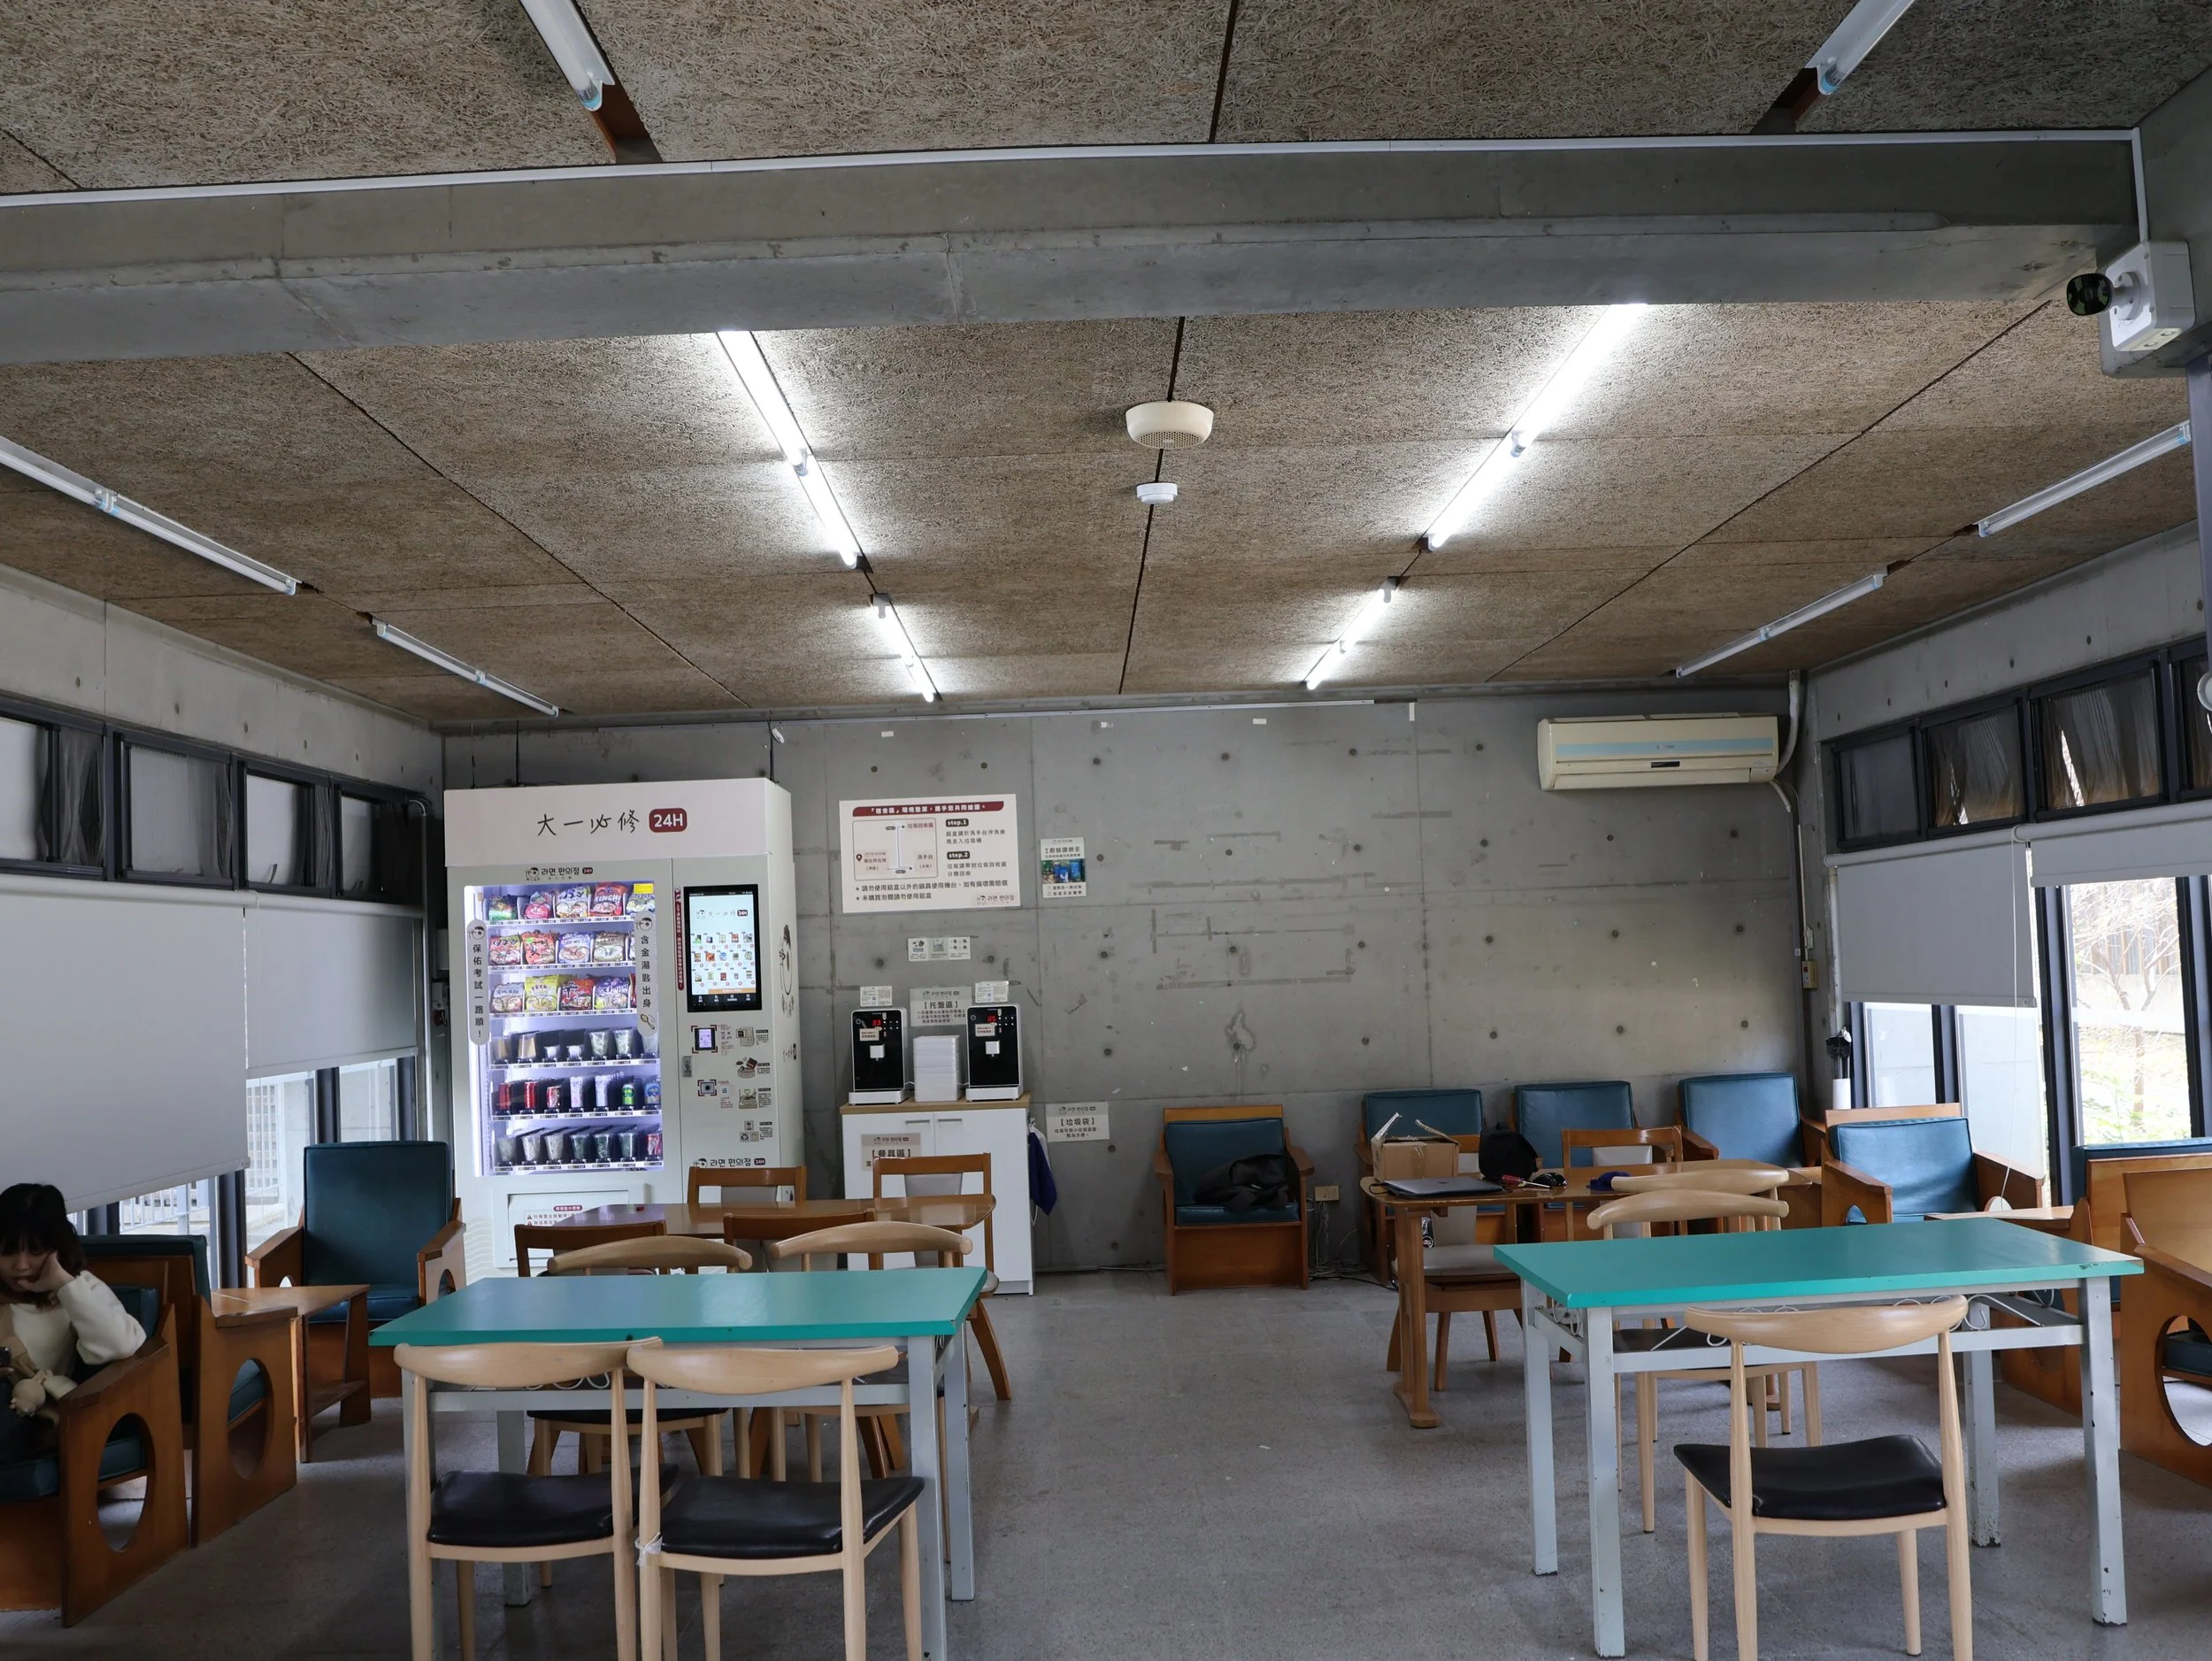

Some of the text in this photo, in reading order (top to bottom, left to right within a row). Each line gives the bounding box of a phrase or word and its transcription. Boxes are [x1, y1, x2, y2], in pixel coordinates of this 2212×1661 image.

[536, 809, 684, 837] 大一必修 24H
[541, 867, 556, 876] 라면
[558, 866, 580, 875] 편의점
[641, 935, 651, 1008] 含金湯匙出身
[1061, 1118, 1094, 1127] 【垃圾袋】
[710, 1158, 726, 1168] 라면
[728, 1157, 751, 1167] 편의점
